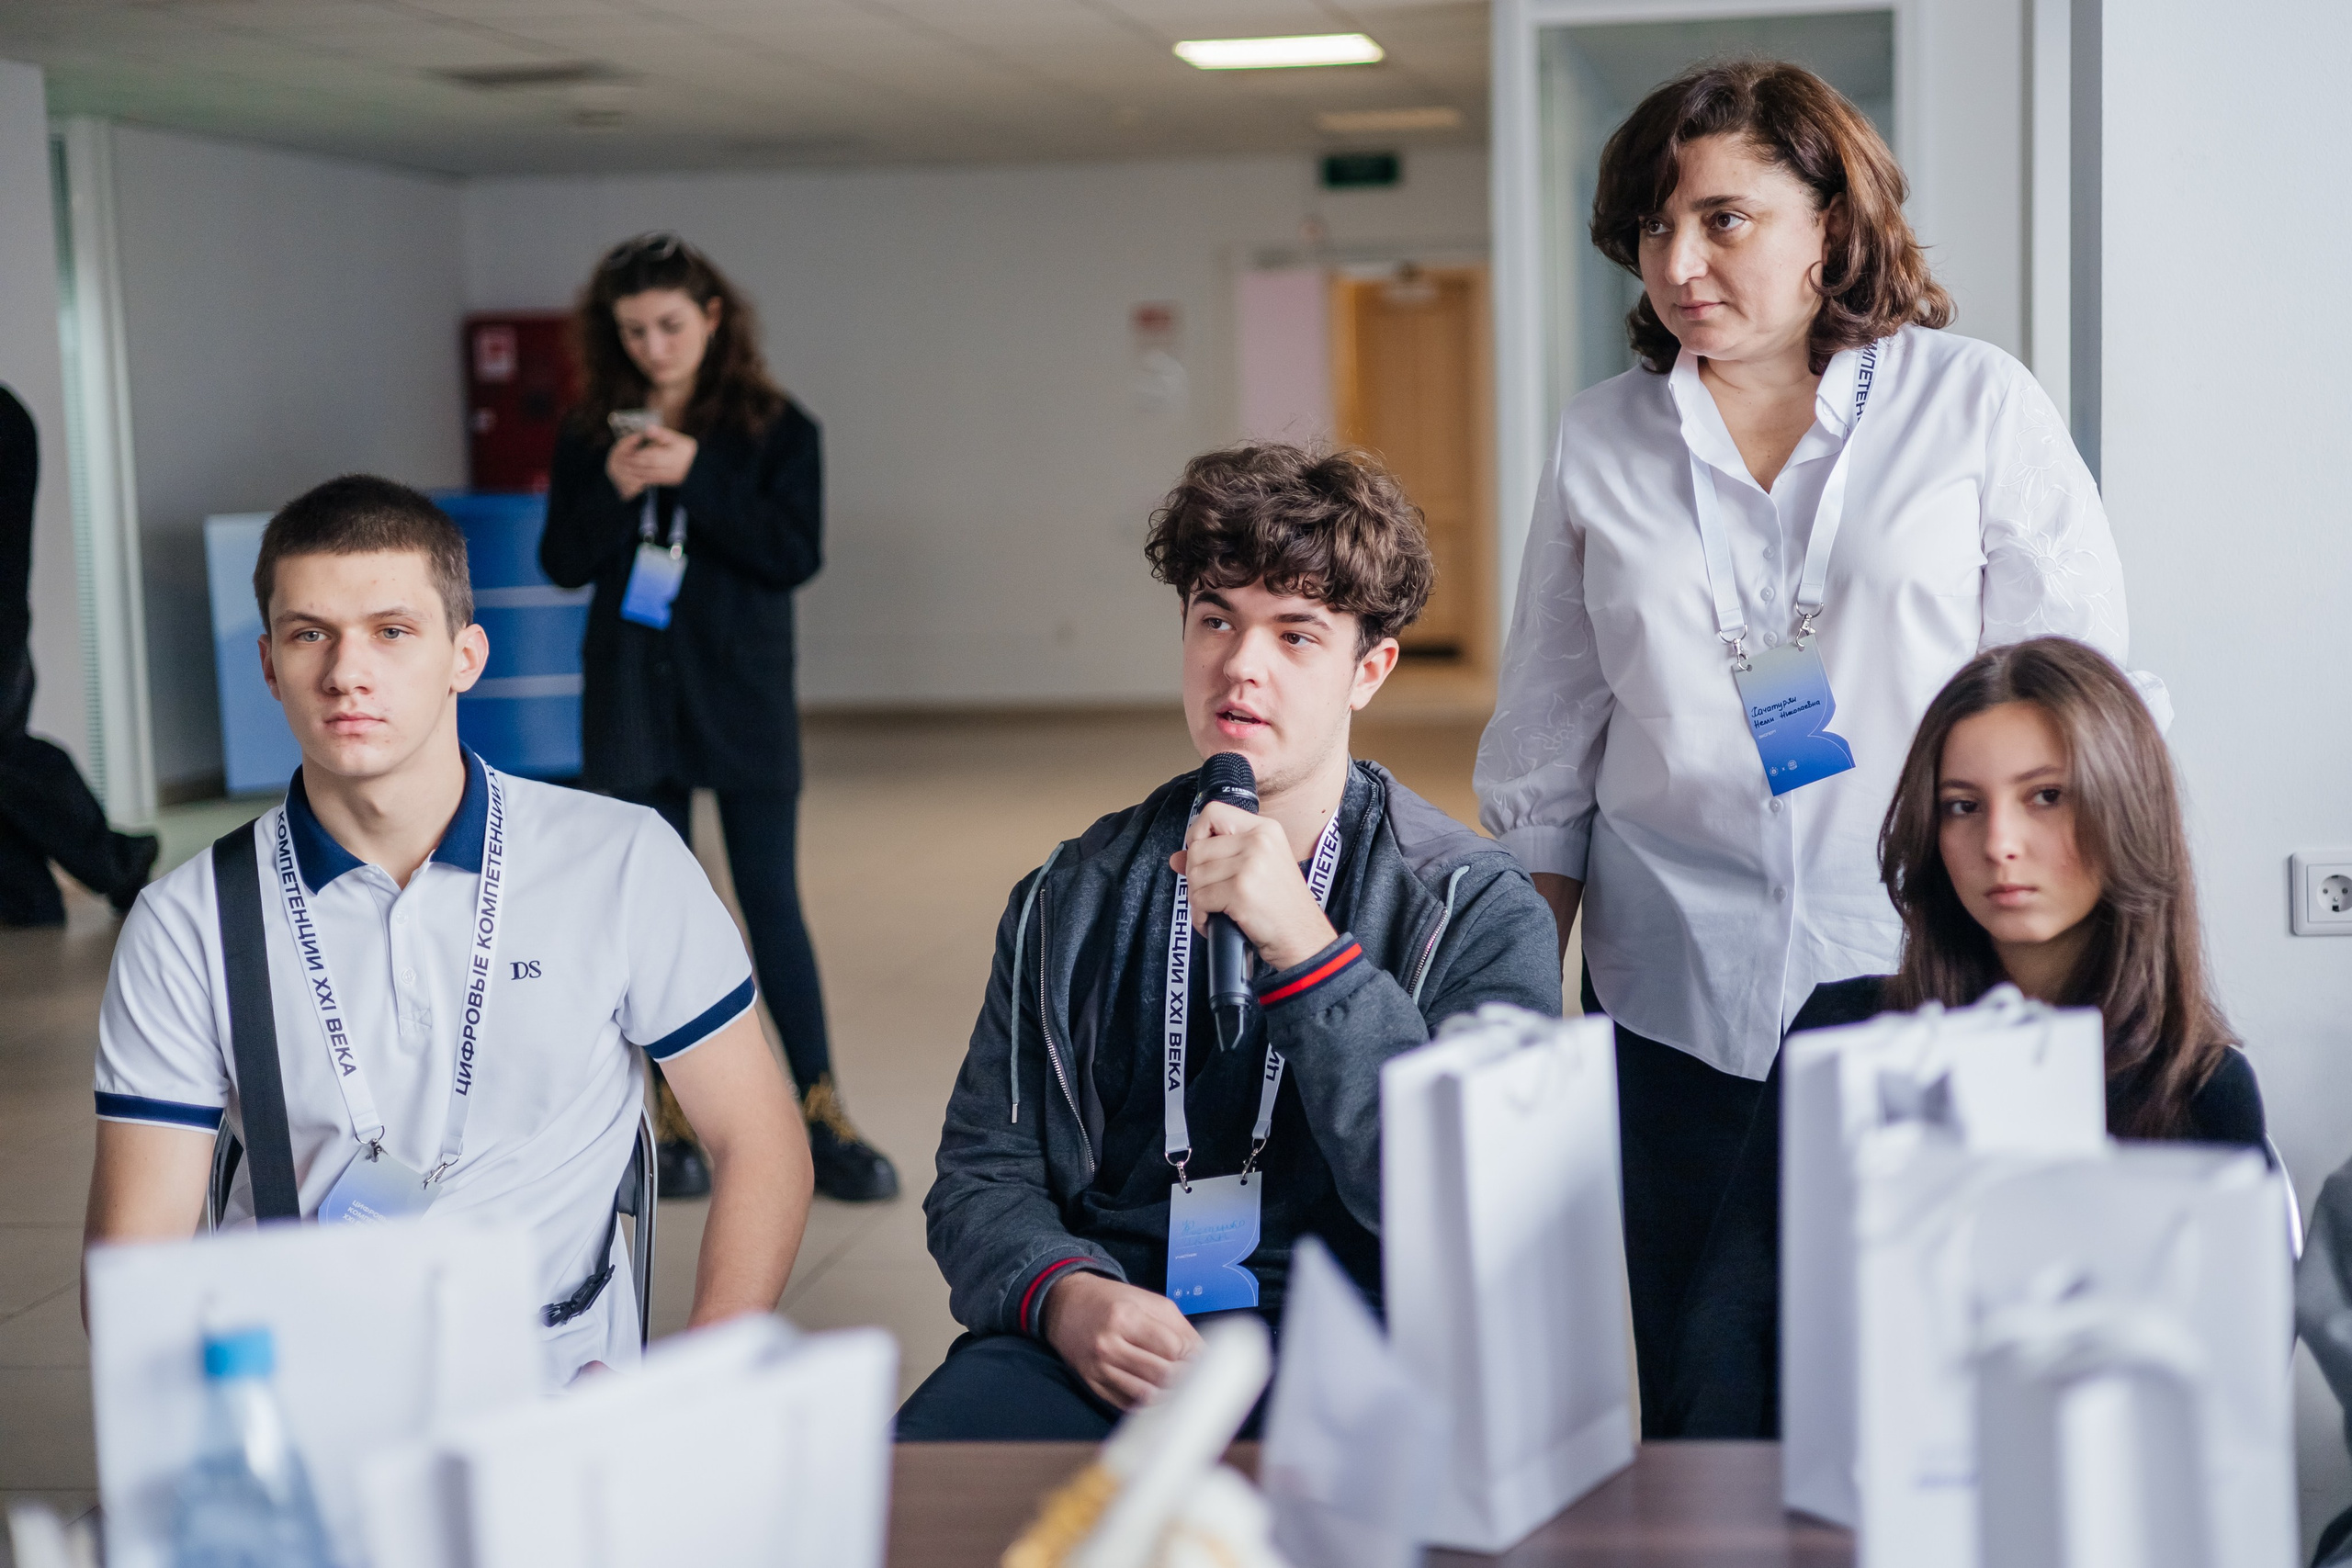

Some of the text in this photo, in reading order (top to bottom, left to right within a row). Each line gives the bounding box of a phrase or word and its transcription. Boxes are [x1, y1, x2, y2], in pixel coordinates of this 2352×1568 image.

[1856, 340, 1878, 423] МПЕТЕН
[277, 812, 324, 971] КОМПЕТЕНЦИИ
[325, 1018, 356, 1077] ВЕКА
[455, 954, 489, 1096] ЦИФРОВЫЕ
[477, 783, 503, 951] КОМПЕТЕНЦИИ
[510, 961, 542, 980] DS
[1170, 877, 1189, 984] ЕТЕНЦИИ
[1168, 1032, 1182, 1091] ВЕКА
